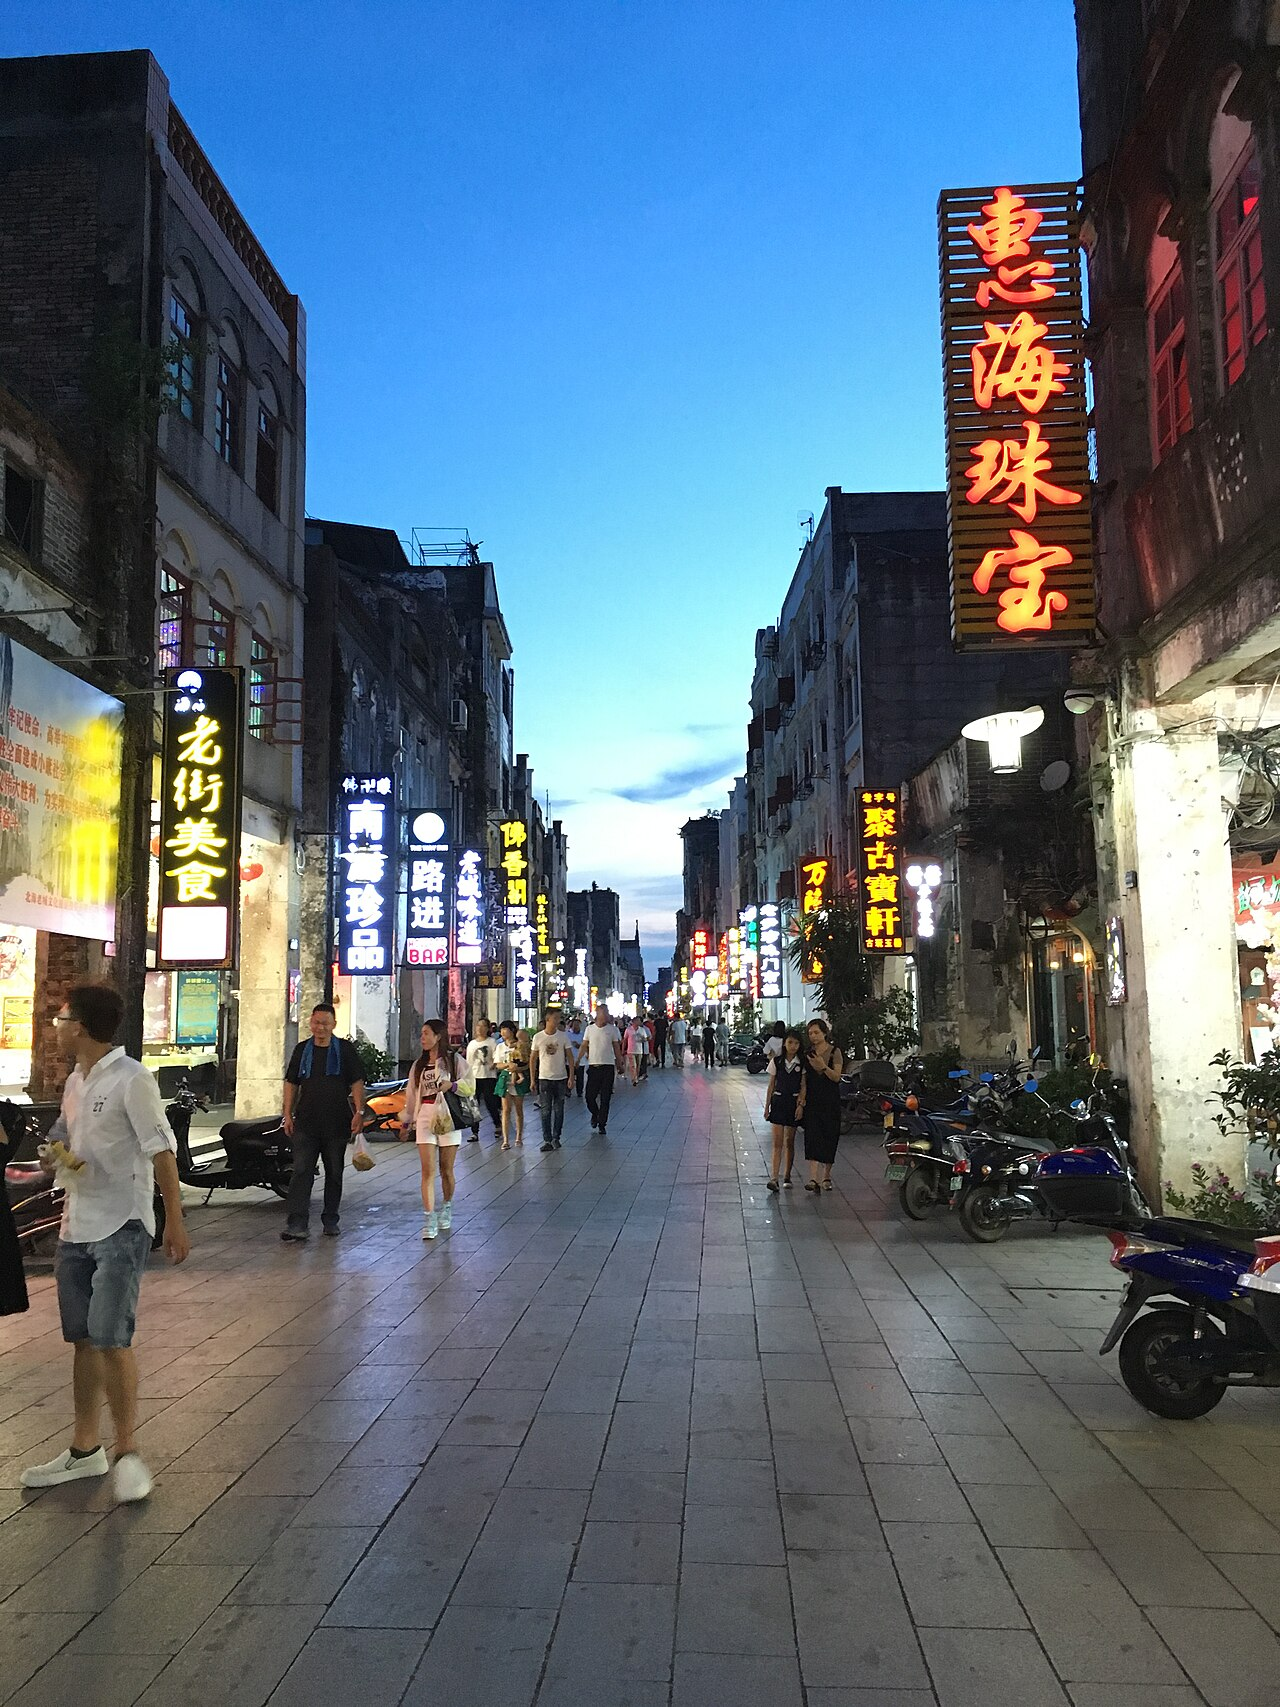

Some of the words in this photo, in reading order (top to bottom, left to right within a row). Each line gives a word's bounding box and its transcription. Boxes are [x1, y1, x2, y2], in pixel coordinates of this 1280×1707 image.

[966, 187, 1082, 632] 惠海珠宝
[165, 715, 227, 902] 老街美食
[411, 859, 445, 929] 路进
[863, 807, 900, 936] 聚古寶軒
[409, 949, 446, 963] BAR
[93, 1102, 104, 1112] 27
